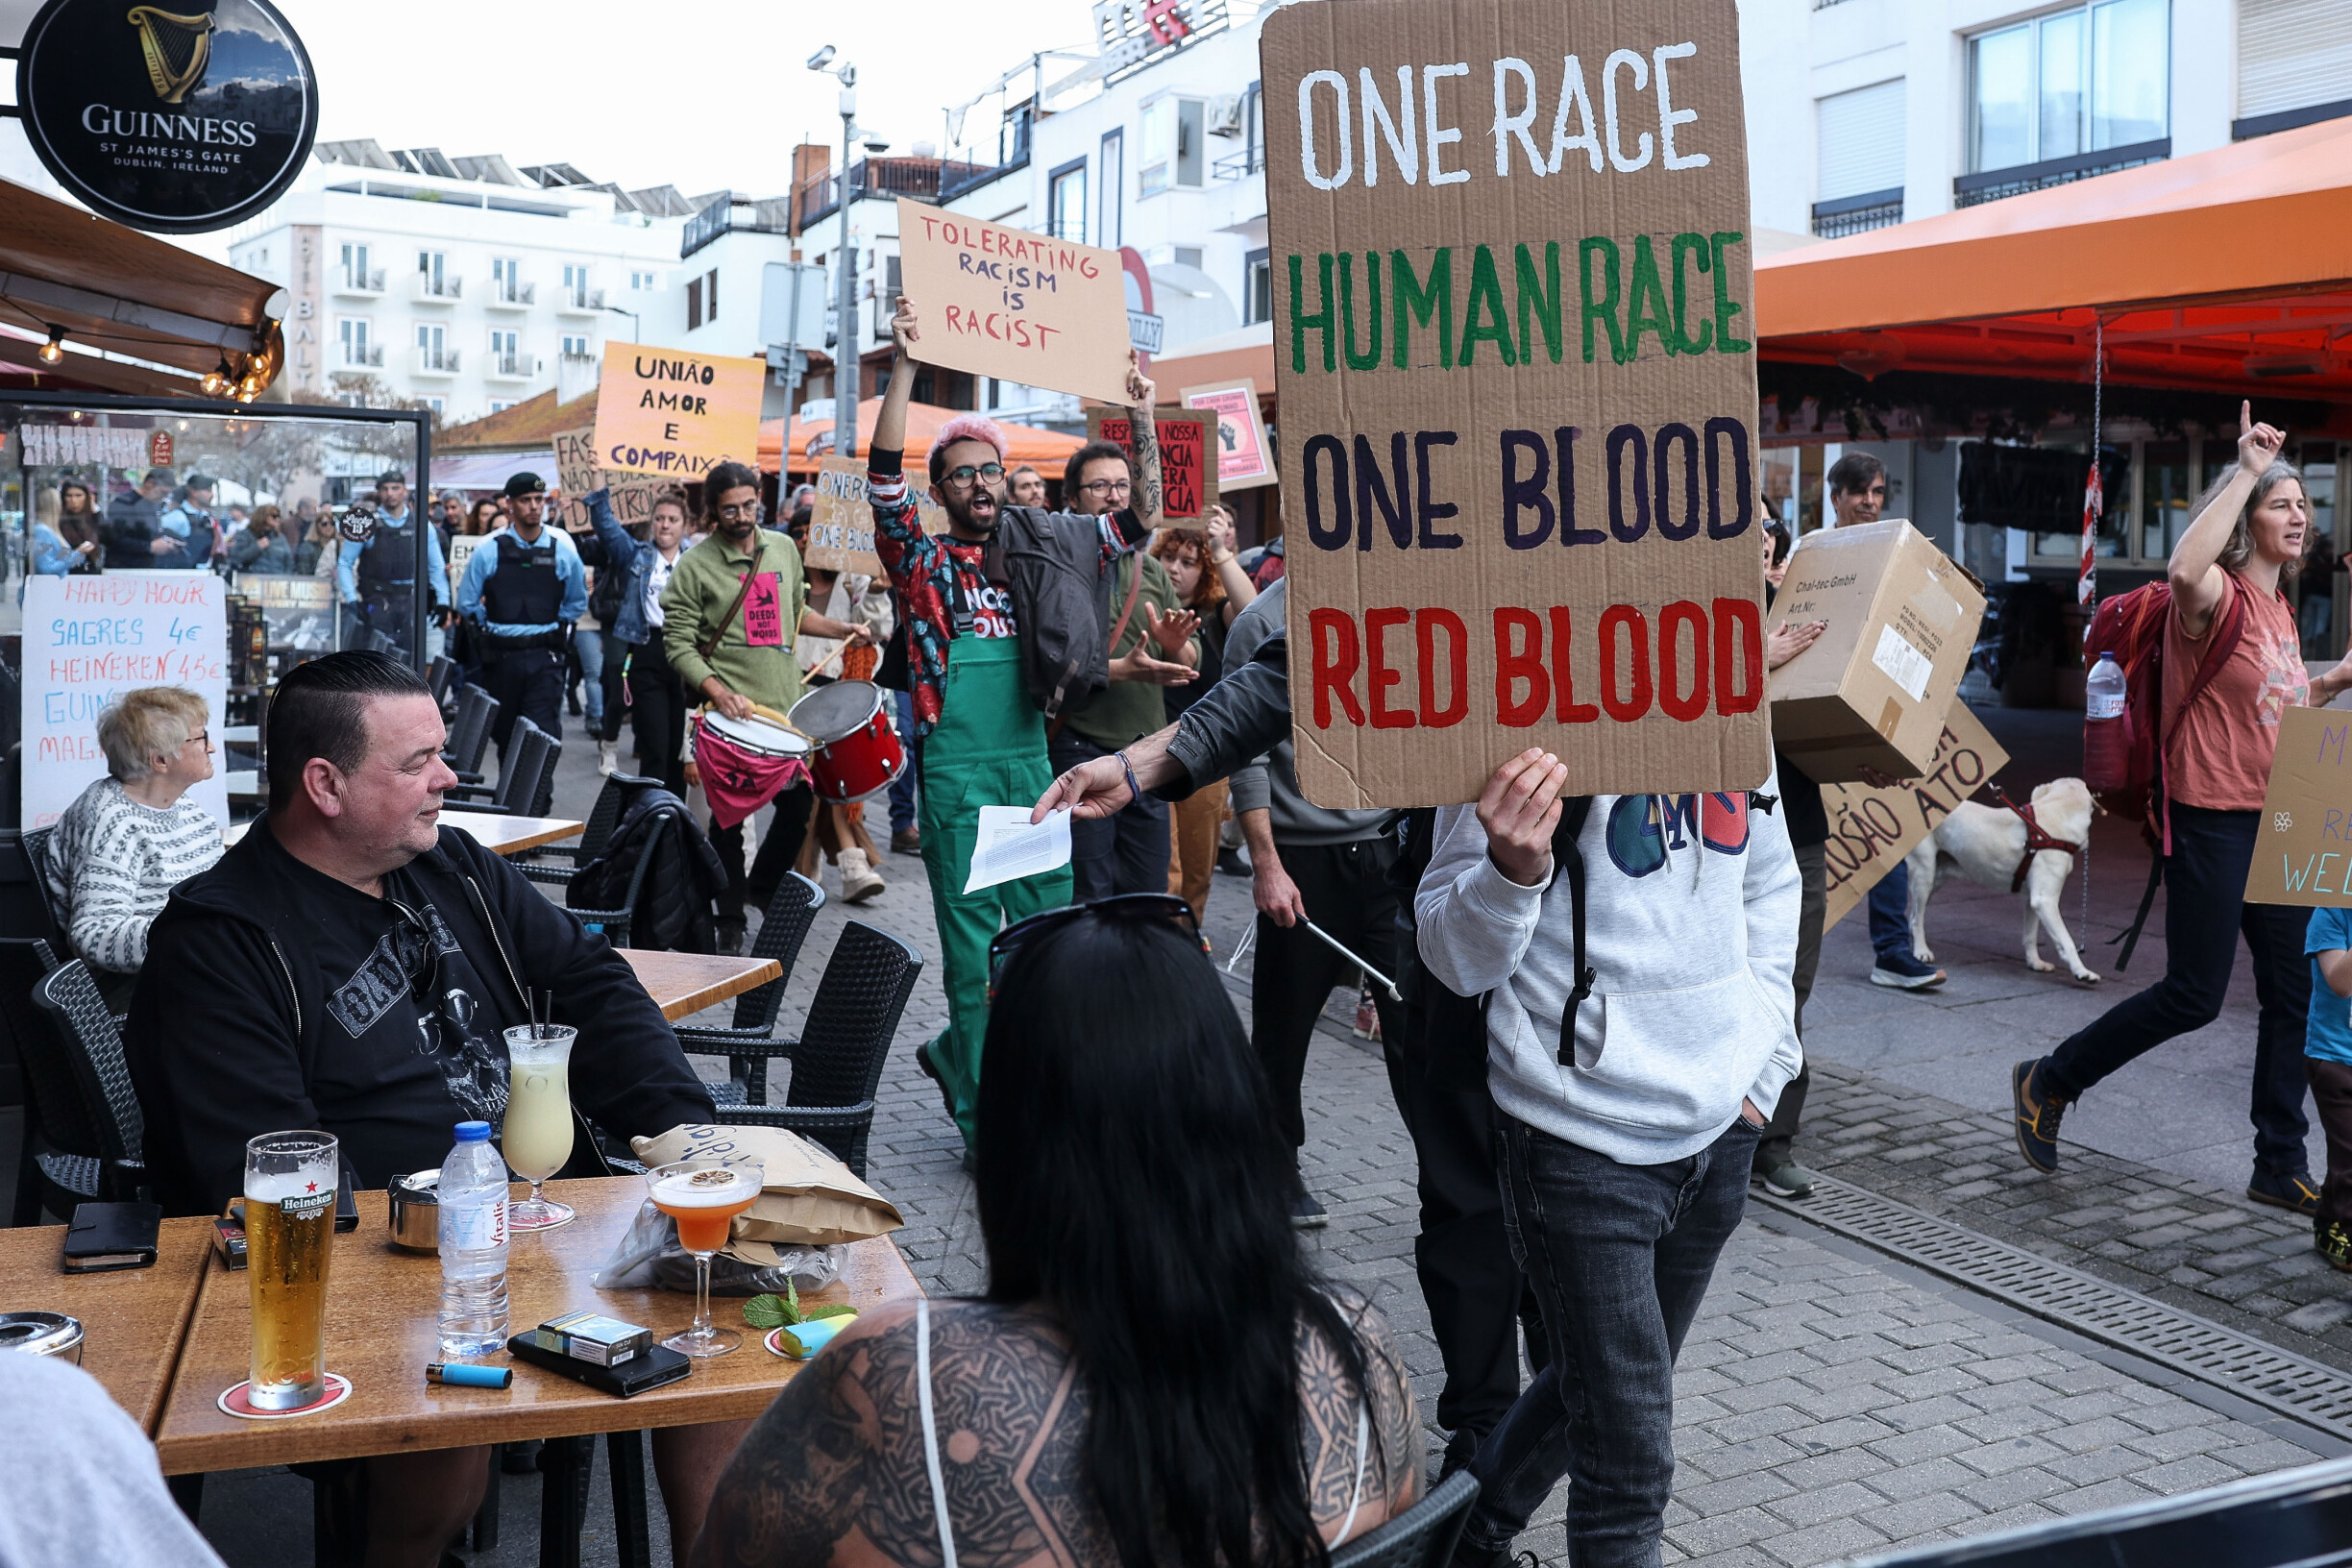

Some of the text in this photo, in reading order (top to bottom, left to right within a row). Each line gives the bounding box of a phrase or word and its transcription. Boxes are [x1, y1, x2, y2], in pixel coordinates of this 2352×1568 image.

[82, 103, 257, 147] GUINNESS
[1298, 41, 1710, 190] ONE RACE
[100, 143, 241, 163] ST JAMES'S GATE
[173, 162, 229, 174] IRELAND
[1287, 231, 1752, 374] HUMAN RACE
[635, 355, 714, 385] UNIÃO
[640, 389, 706, 415] AMOR
[664, 423, 678, 440] E
[1165, 425, 1199, 441] NOSSA
[611, 445, 730, 474] COMPAIX
[1303, 417, 1752, 551] ONE BLOOD
[65, 577, 208, 606] HAPPY HOUR
[1830, 574, 1857, 588] GmbH
[748, 610, 775, 621] DEEDS
[52, 617, 202, 646] SAGRES 4€
[750, 629, 777, 639] WORDS
[1308, 597, 1763, 729] RED BLOOD
[1915, 748, 1985, 829] ATO
[284, 1193, 332, 1210] Heineken
[490, 1200, 504, 1248] Vitalis
